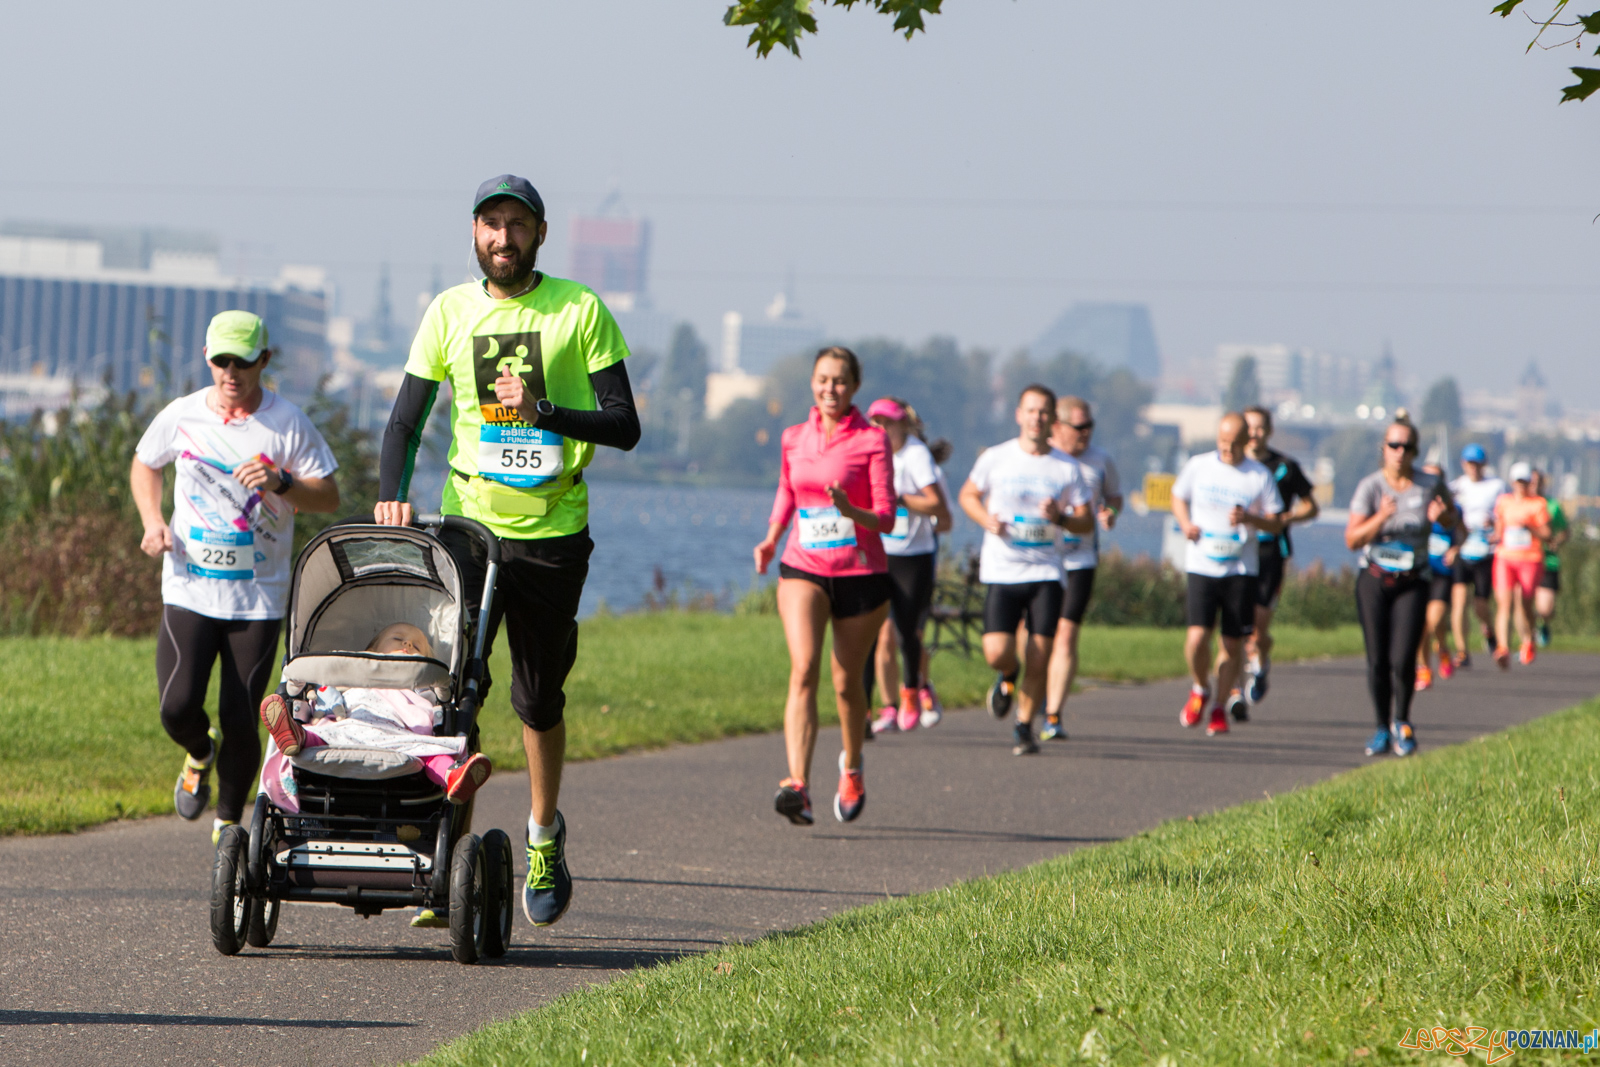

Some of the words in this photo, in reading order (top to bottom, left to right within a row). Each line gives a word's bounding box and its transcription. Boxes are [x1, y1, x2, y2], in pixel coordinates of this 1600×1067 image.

[495, 406, 520, 420] nig
[500, 428, 543, 439] zaBIEGaj
[501, 448, 542, 469] 555
[812, 522, 839, 537] 554
[202, 548, 237, 566] 225
